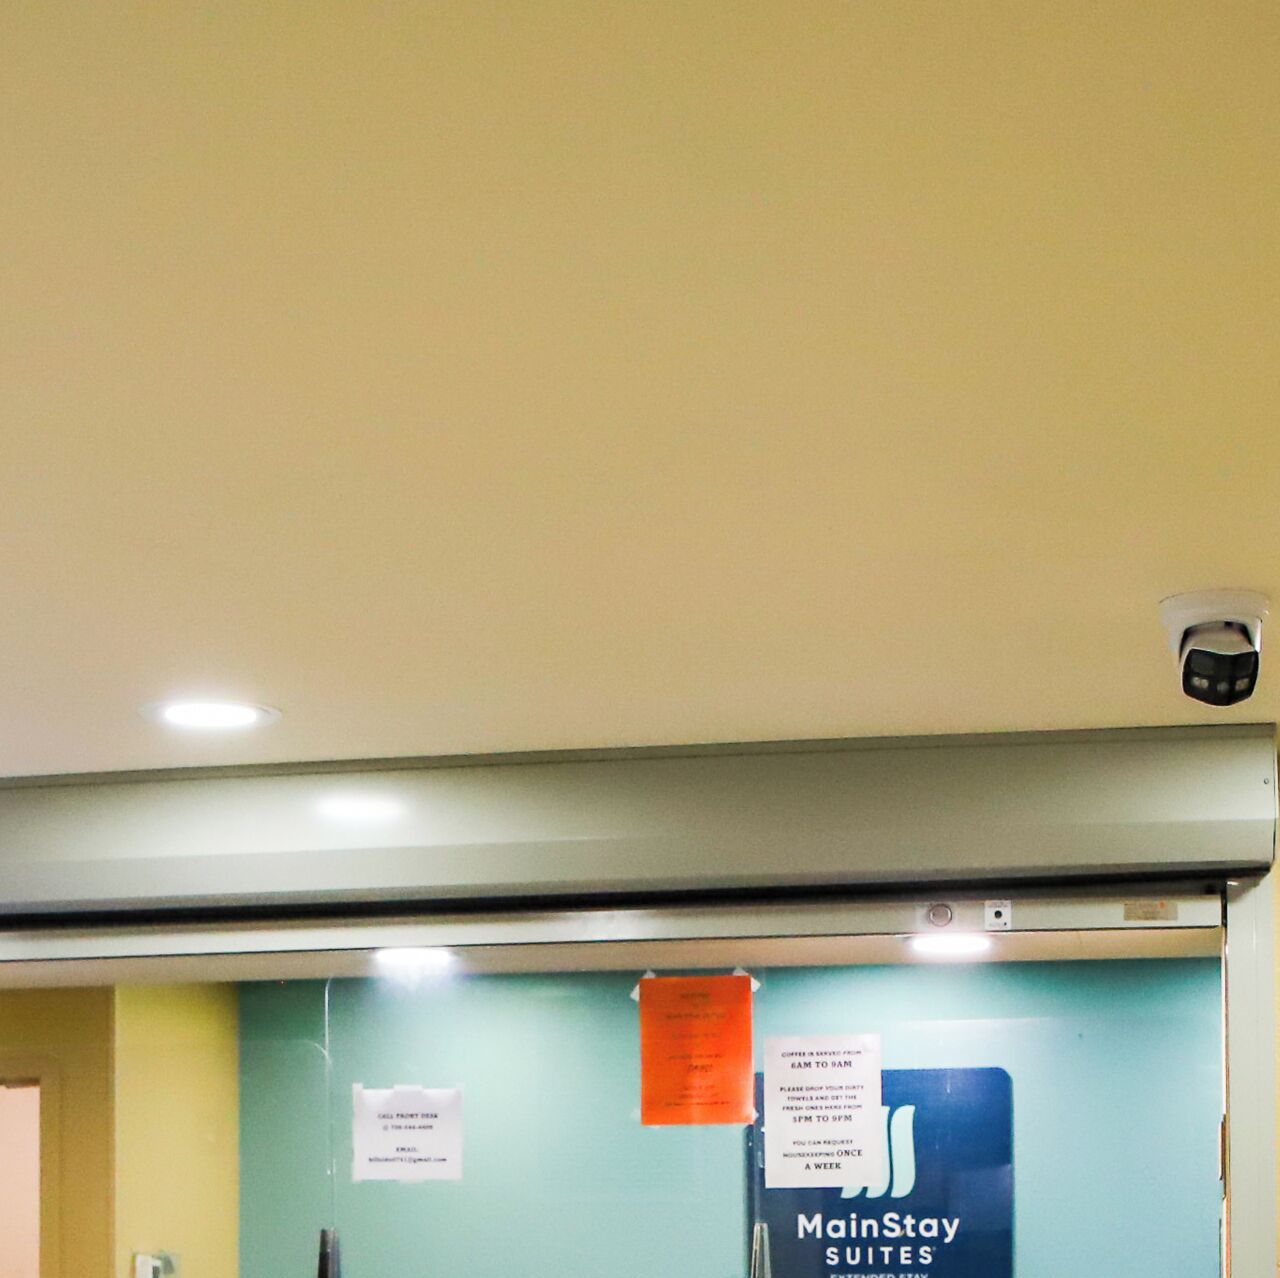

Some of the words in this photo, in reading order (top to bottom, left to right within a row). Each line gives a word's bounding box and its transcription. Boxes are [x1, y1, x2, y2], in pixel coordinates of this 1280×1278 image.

[791, 1061, 812, 1069] 6AM
[836, 1149, 863, 1157] ONCE
[798, 1212, 959, 1243] MainStay
[826, 1246, 933, 1265] SUITES
